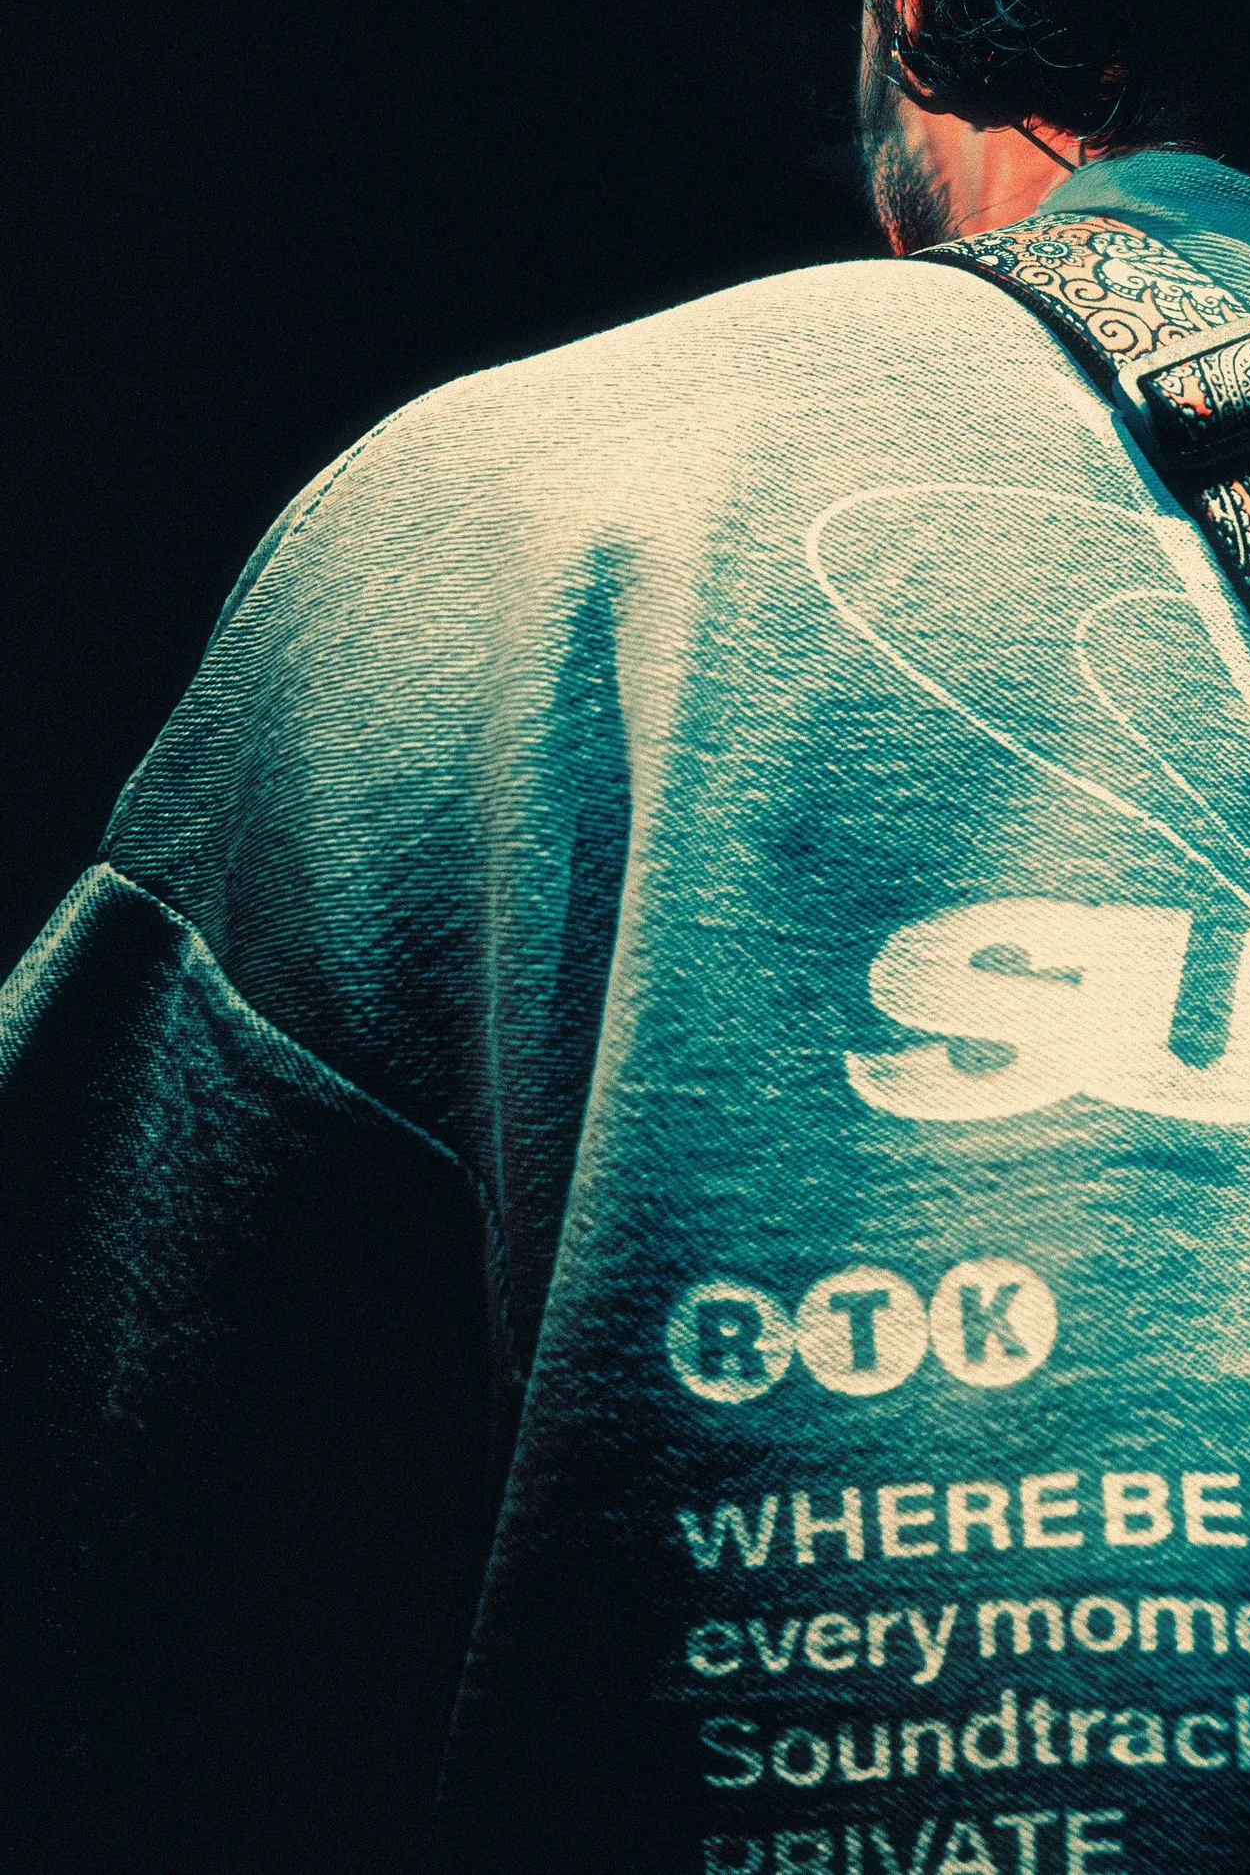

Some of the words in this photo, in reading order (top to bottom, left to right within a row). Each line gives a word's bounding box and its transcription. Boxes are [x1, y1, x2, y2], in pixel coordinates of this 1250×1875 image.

[688, 1273, 1041, 1384] RTK
[677, 1471, 1085, 1570] WHERE
[686, 1603, 959, 1685] every
[702, 1807, 1127, 1875] PRIVATE
